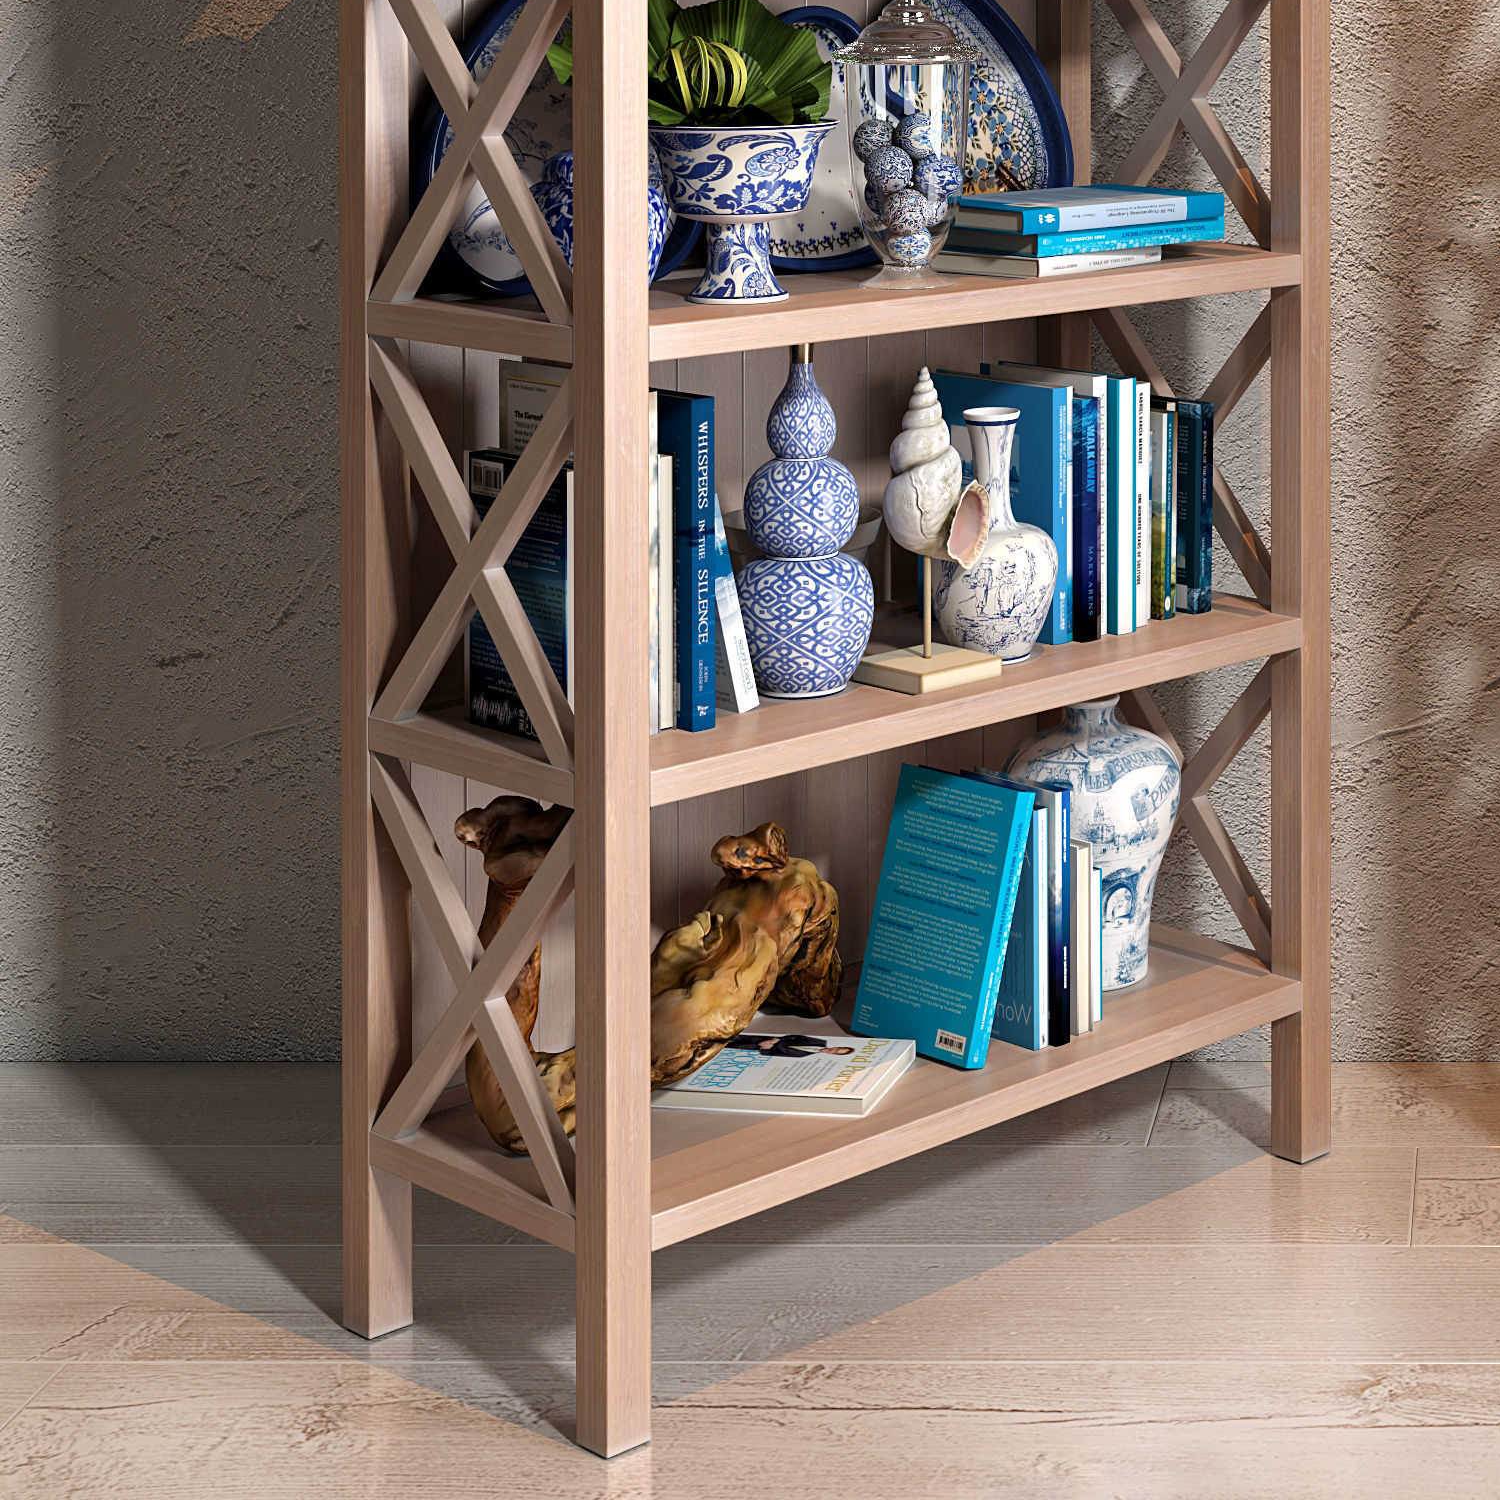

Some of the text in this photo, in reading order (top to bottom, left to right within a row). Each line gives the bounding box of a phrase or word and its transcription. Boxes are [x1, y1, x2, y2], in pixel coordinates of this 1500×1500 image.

[1121, 225, 1205, 237] SOCIAL MEDIA RECRUITMENT
[1086, 424, 1096, 493] WALKAWAY
[697, 420, 709, 645] WHISPERS IN THE SILENCE
[996, 823, 1023, 949] SOCIAL MEDIA RECRUITMENT
[749, 1056, 773, 1068] THE
[851, 1039, 889, 1062] David
[703, 1049, 760, 1088] PORTER
[824, 1065, 866, 1093] Porter
